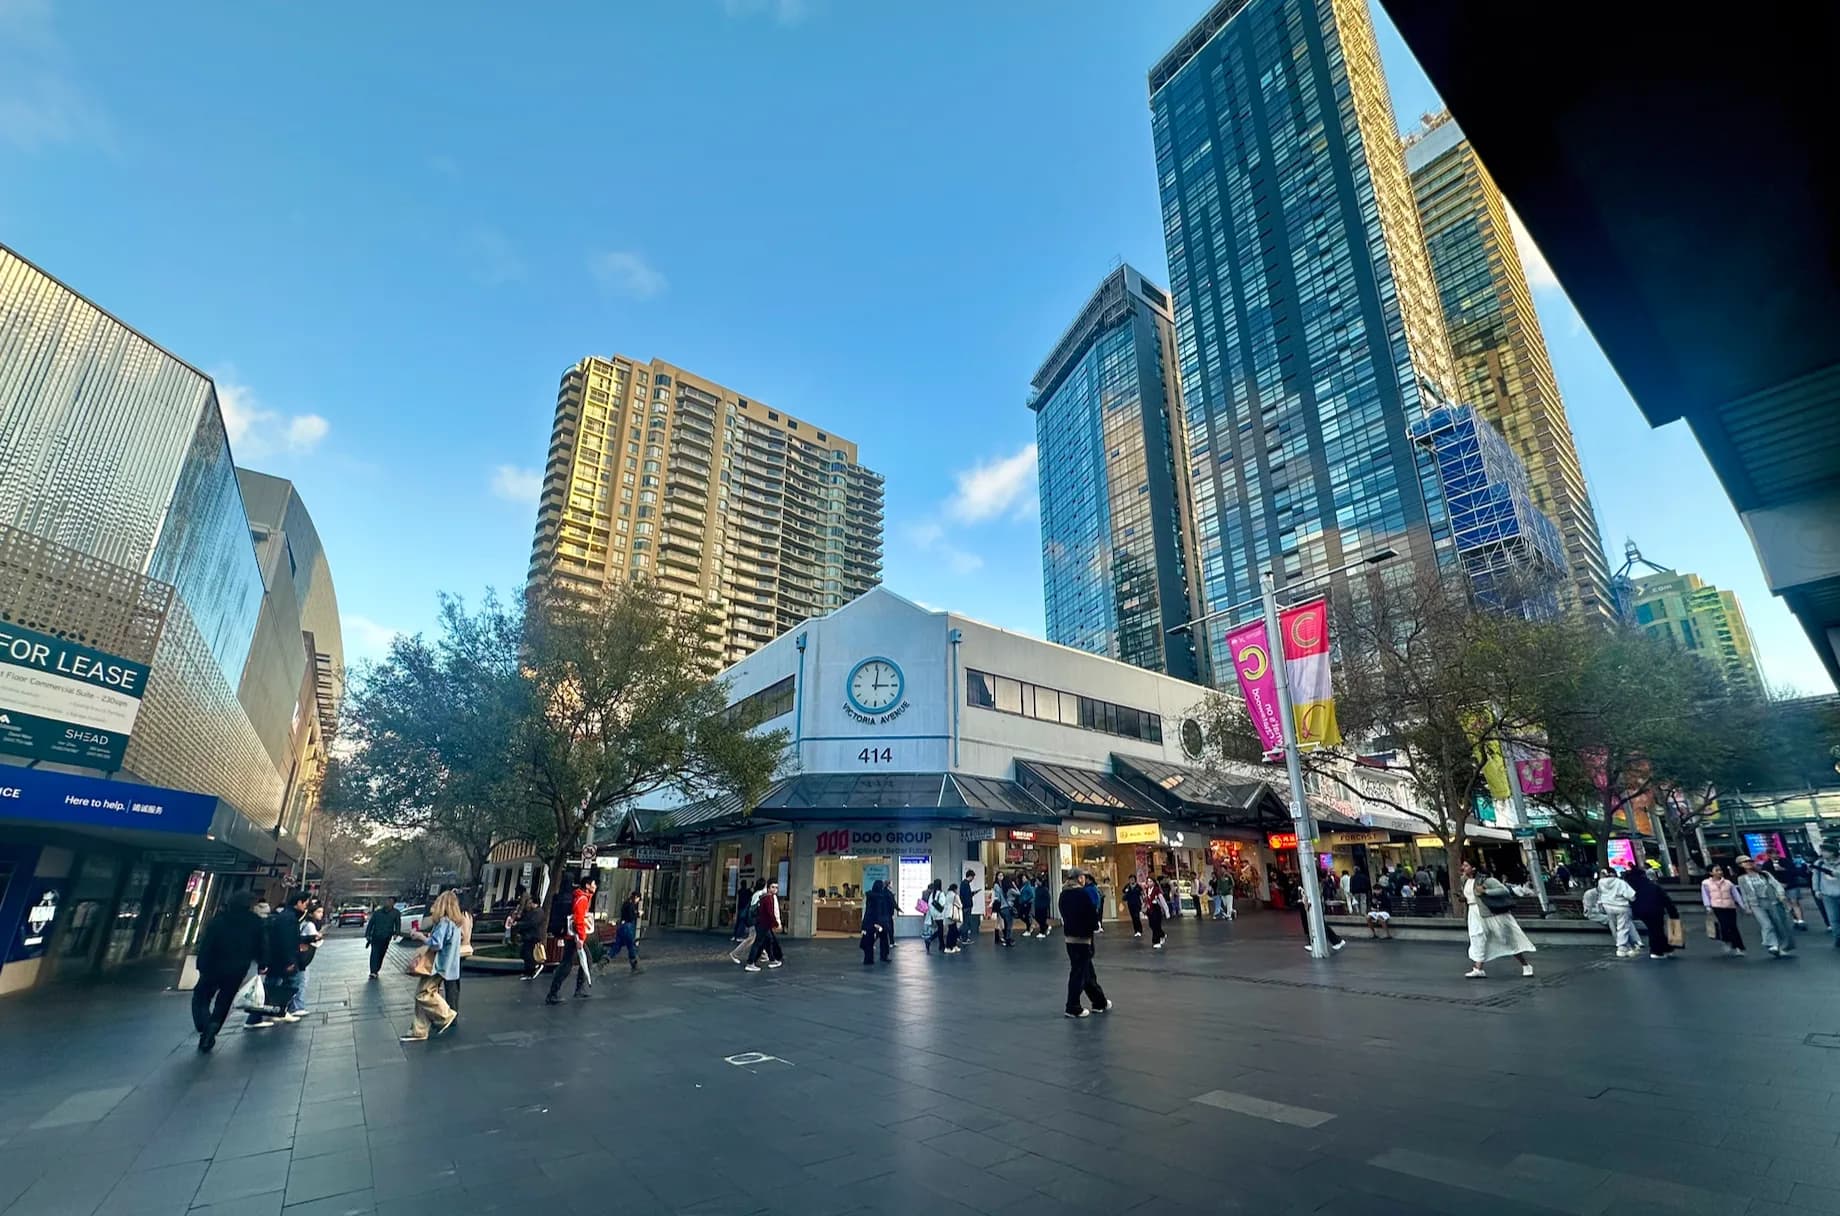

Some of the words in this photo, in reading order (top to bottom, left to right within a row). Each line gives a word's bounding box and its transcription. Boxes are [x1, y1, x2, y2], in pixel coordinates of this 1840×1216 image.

[57, 651, 138, 690] LEASE
[842, 702, 876, 725] VICTORIA
[880, 700, 911, 724] AVENUE
[64, 728, 109, 746] SHEAD
[858, 747, 893, 764] 414
[64, 795, 89, 807] Here
[91, 798, 102, 808] to
[103, 800, 125, 812] help.
[852, 831, 882, 844] DOO
[886, 831, 932, 844] GROUP
